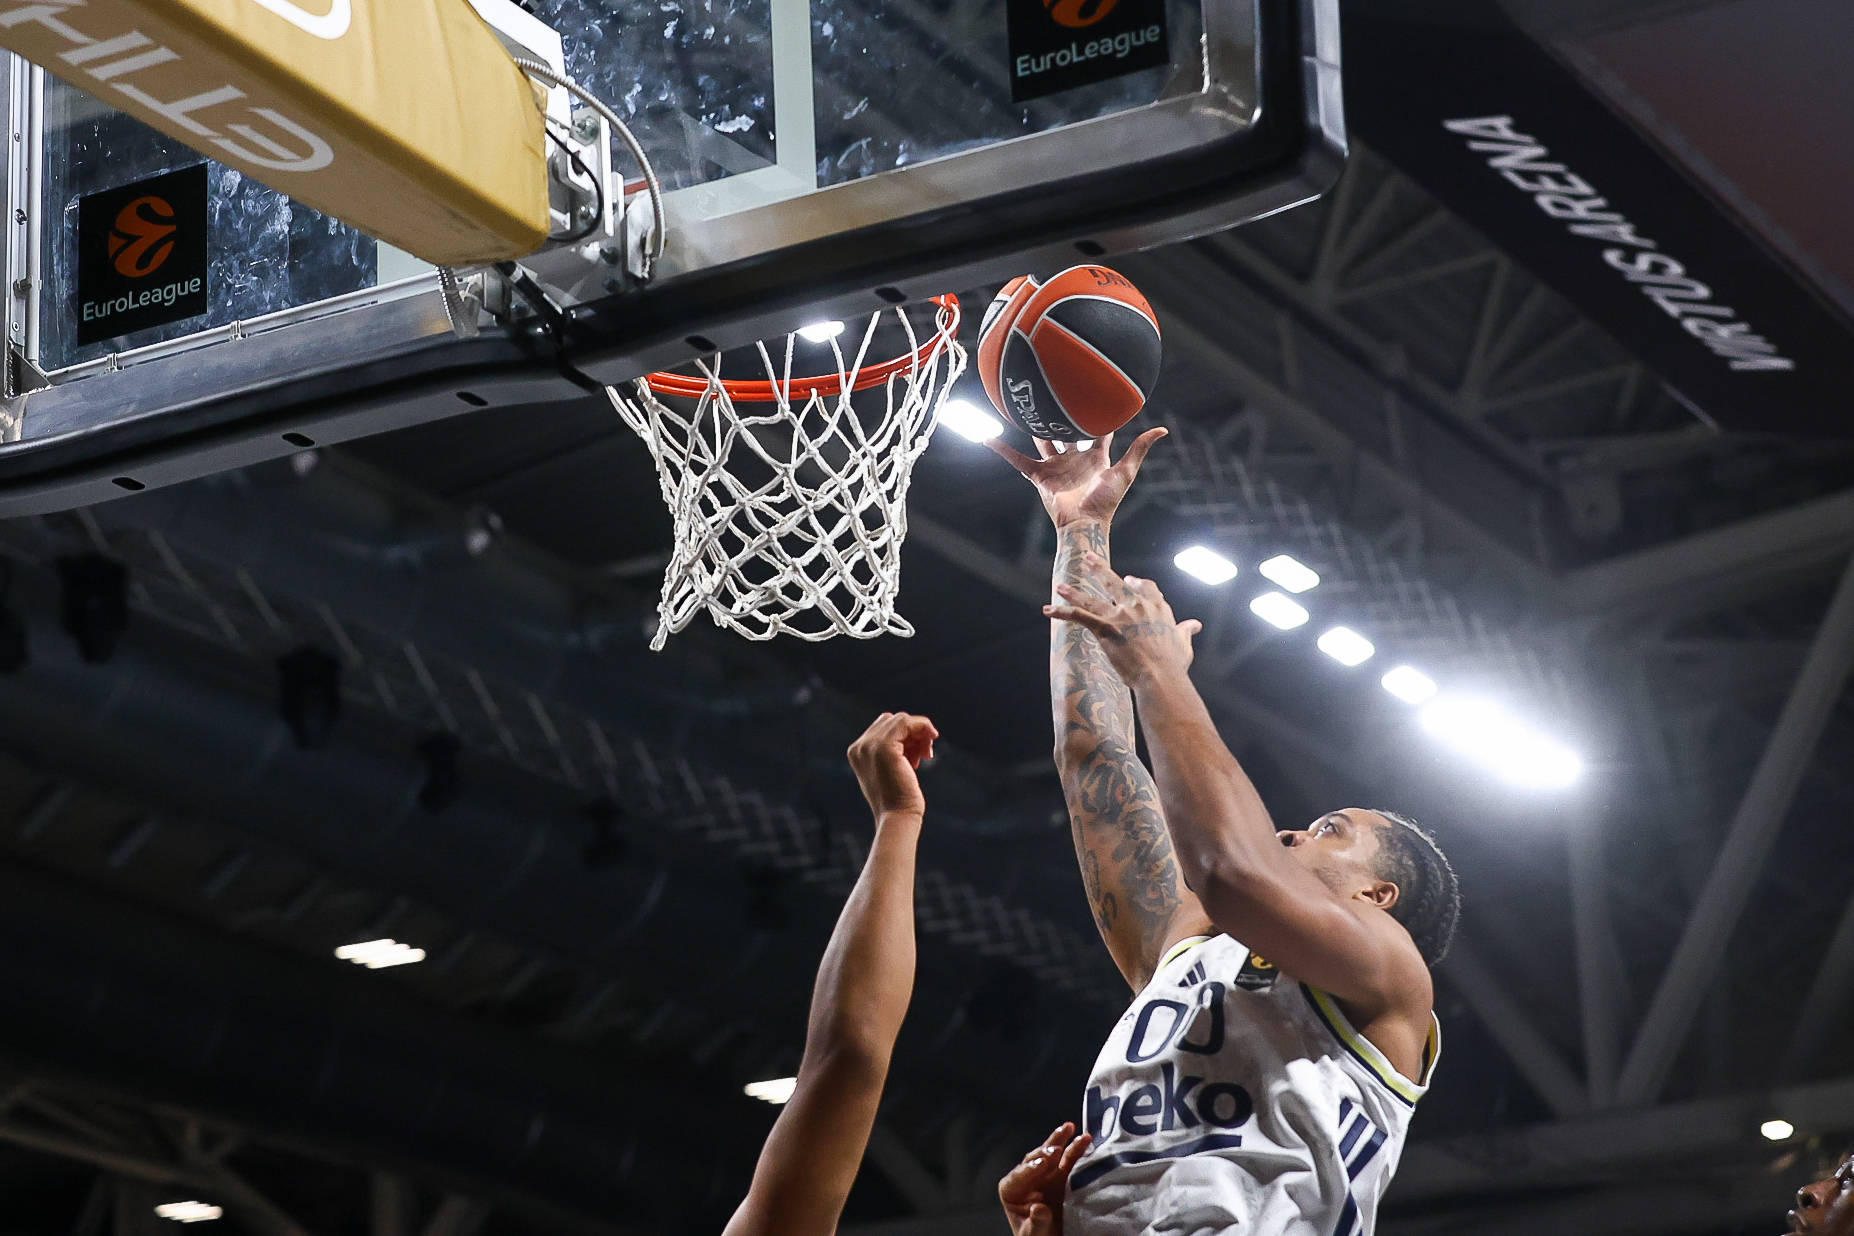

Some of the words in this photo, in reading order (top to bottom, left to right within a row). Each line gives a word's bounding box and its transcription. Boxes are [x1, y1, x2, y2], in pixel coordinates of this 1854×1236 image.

[1016, 24, 1161, 79] EuroLeague
[1442, 114, 1657, 250] ARENA
[82, 275, 202, 322] EuroLeague
[1602, 248, 1795, 371] VIRTUS
[1087, 1063, 1252, 1148] beko
